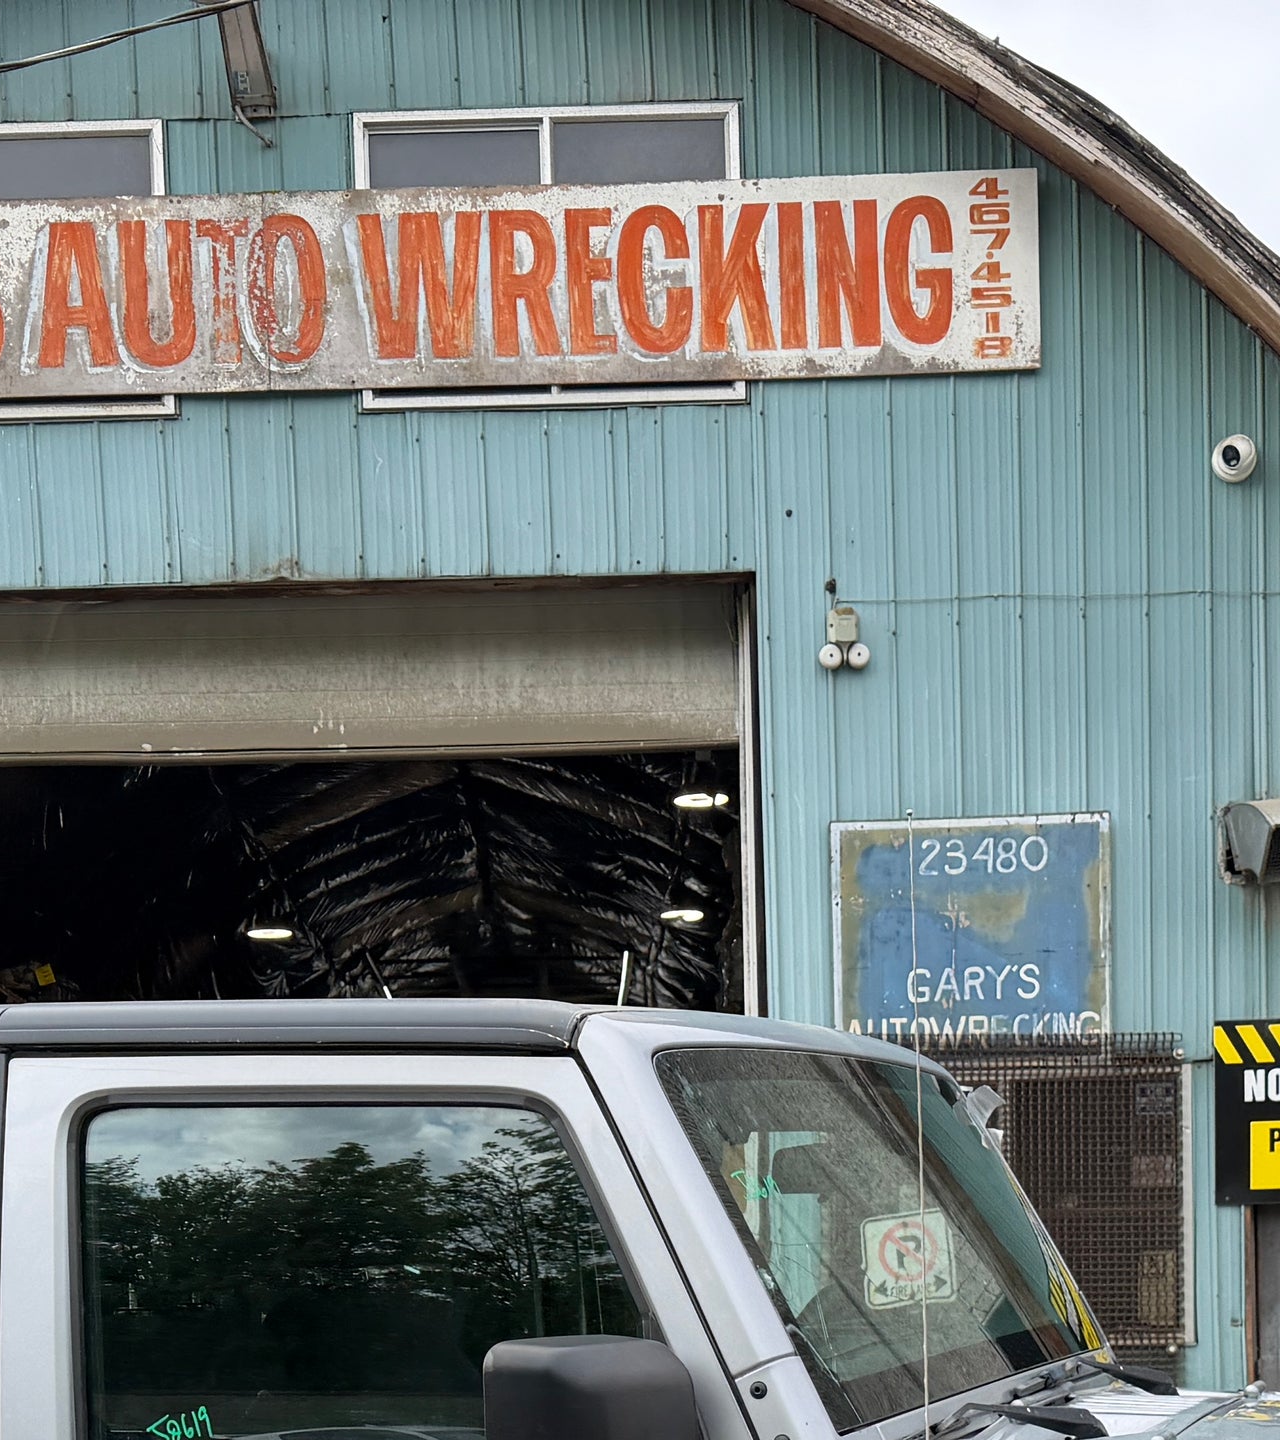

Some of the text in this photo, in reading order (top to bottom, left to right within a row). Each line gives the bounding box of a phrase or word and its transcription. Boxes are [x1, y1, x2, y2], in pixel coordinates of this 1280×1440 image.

[37, 212, 327, 370] AUTO
[355, 194, 955, 360] WRECKING
[919, 835, 1049, 876] 23480
[906, 963, 1041, 1004] GARY'S
